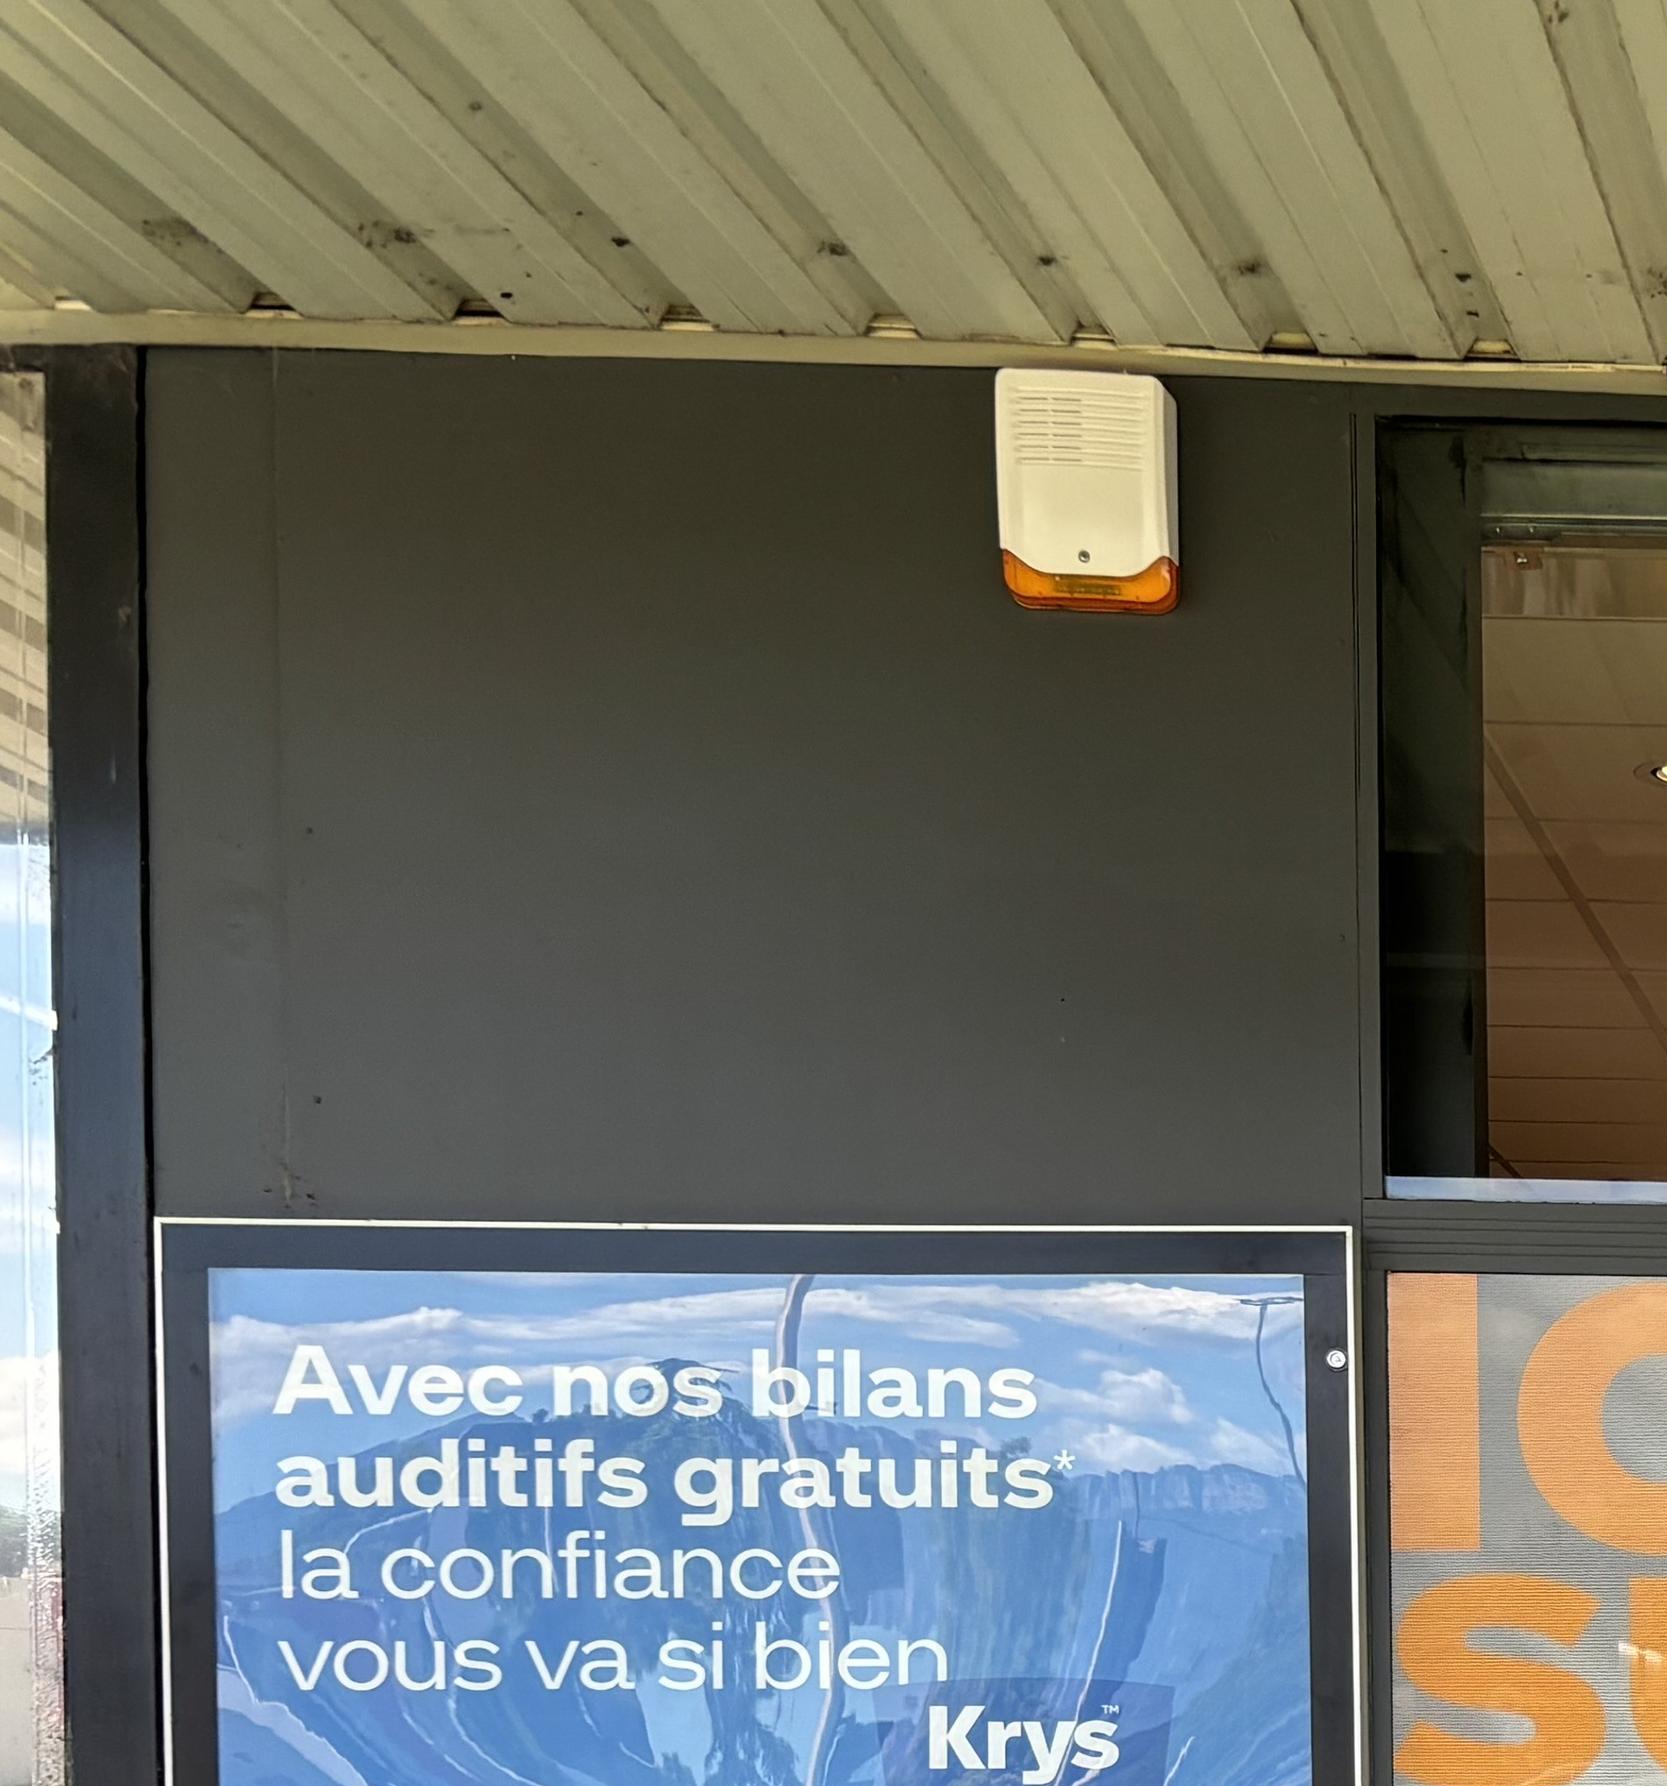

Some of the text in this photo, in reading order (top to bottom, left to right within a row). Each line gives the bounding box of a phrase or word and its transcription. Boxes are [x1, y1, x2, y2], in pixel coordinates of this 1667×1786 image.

[273, 1345, 1037, 1420] Avec nos bilans
[274, 1436, 648, 1510] auditifs
[279, 1527, 840, 1600] la confiance
[279, 1620, 949, 1694] vous va si bien
[927, 1703, 1120, 1786] Krys
